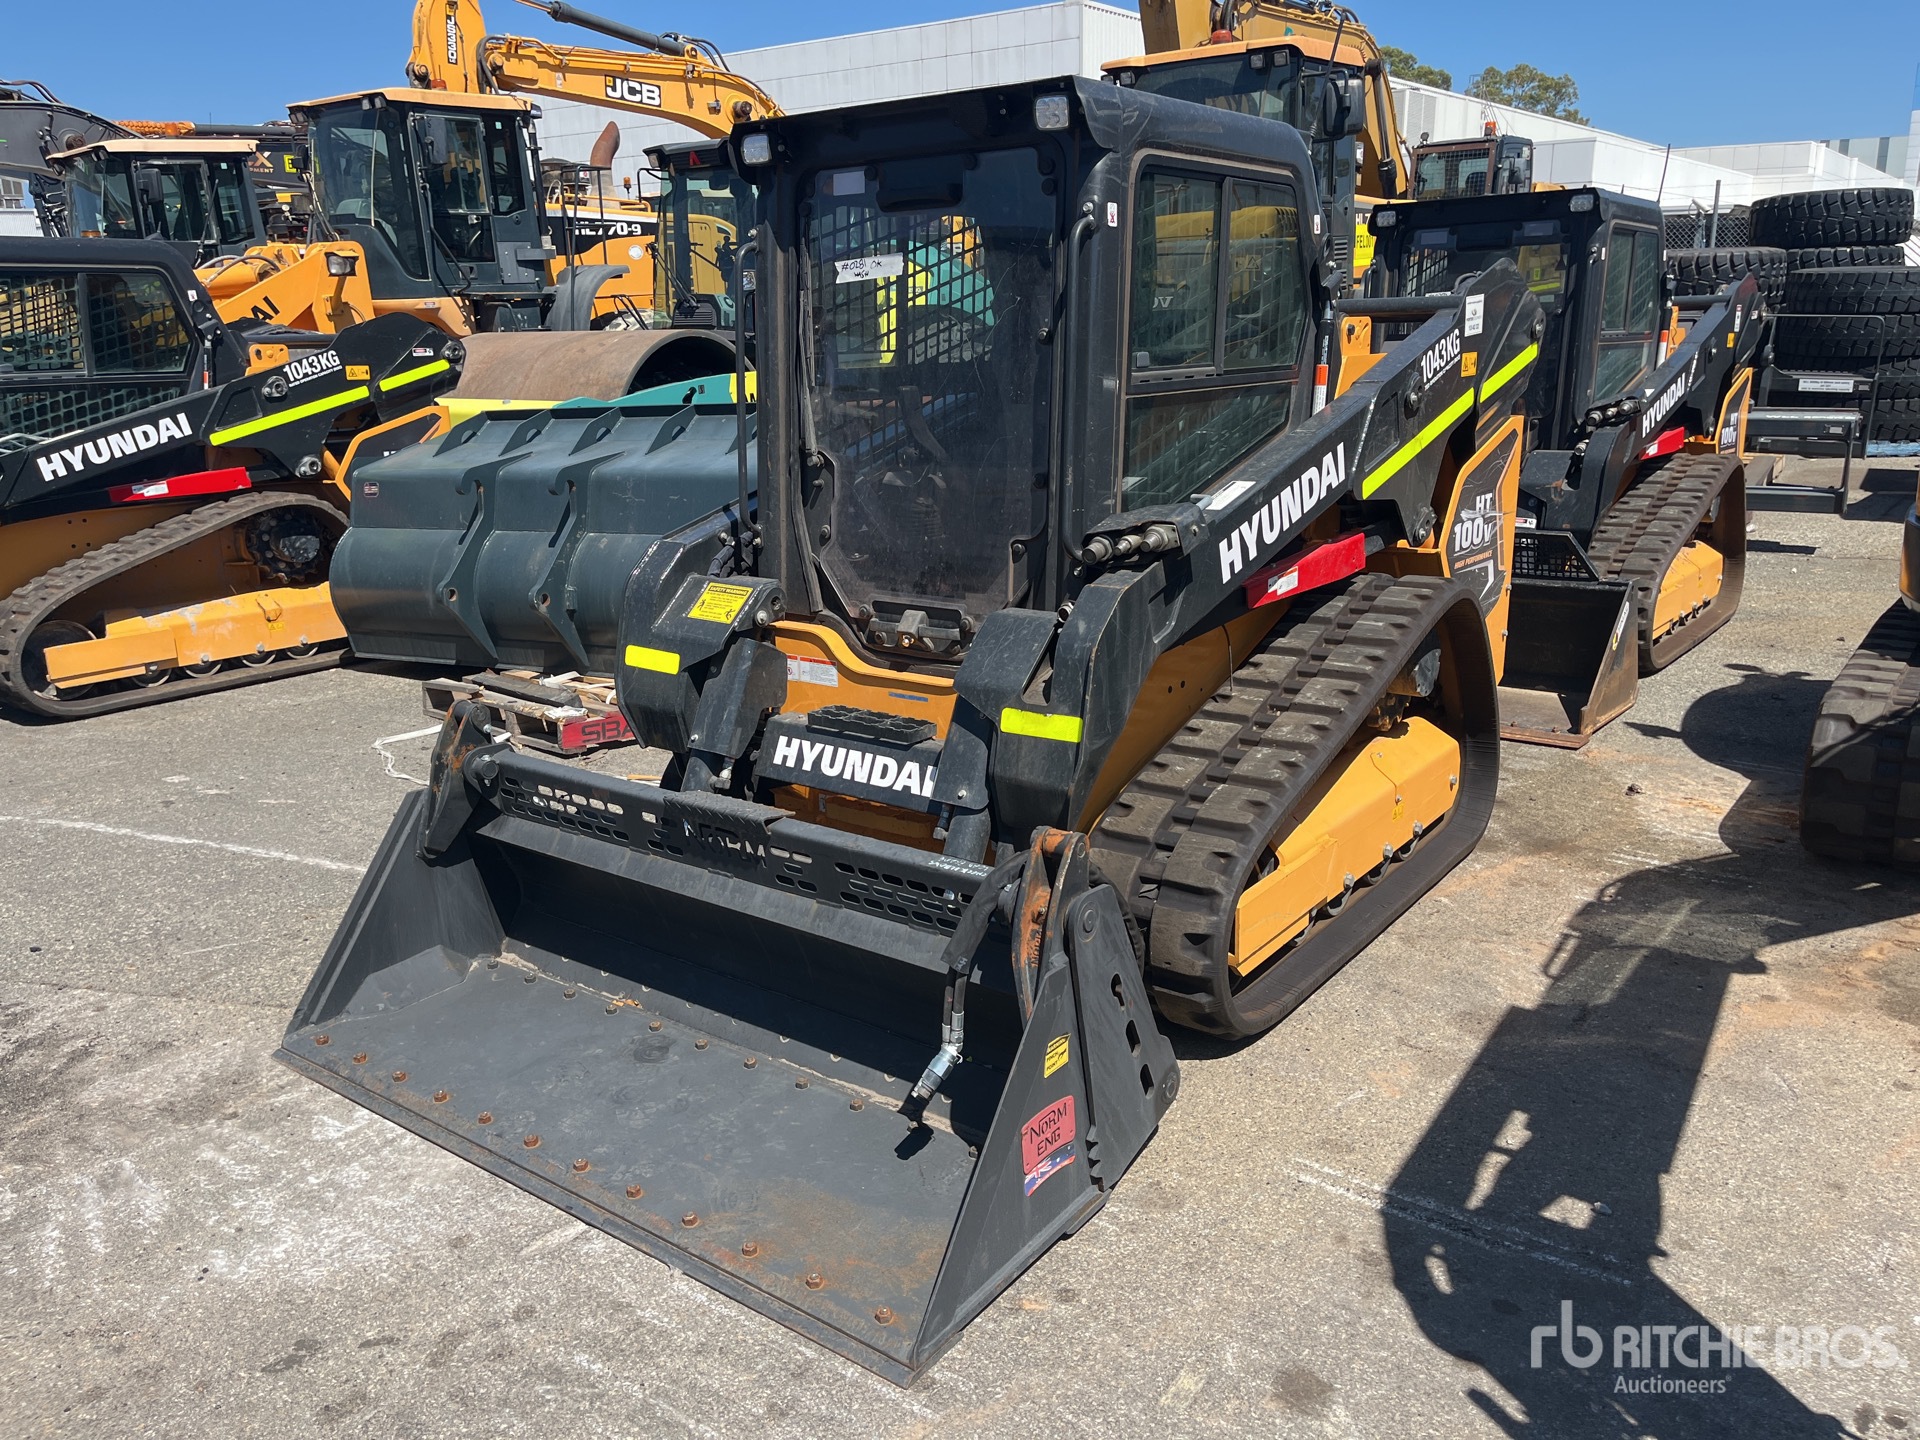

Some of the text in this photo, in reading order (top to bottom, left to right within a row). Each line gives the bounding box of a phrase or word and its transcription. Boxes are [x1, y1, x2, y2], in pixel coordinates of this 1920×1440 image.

[606, 78, 661, 106] JCB
[283, 350, 342, 382] 1043KG
[1420, 328, 1461, 383] 1043KG
[1642, 372, 1686, 439] HYUNDAI
[36, 412, 193, 482] HYUNDAI
[1219, 441, 1346, 585] HYUNDAI
[1476, 492, 1493, 513] HT
[772, 735, 938, 798] HYUNDAI
[1029, 1102, 1067, 1145] NORM
[1037, 1127, 1061, 1157] ENG
